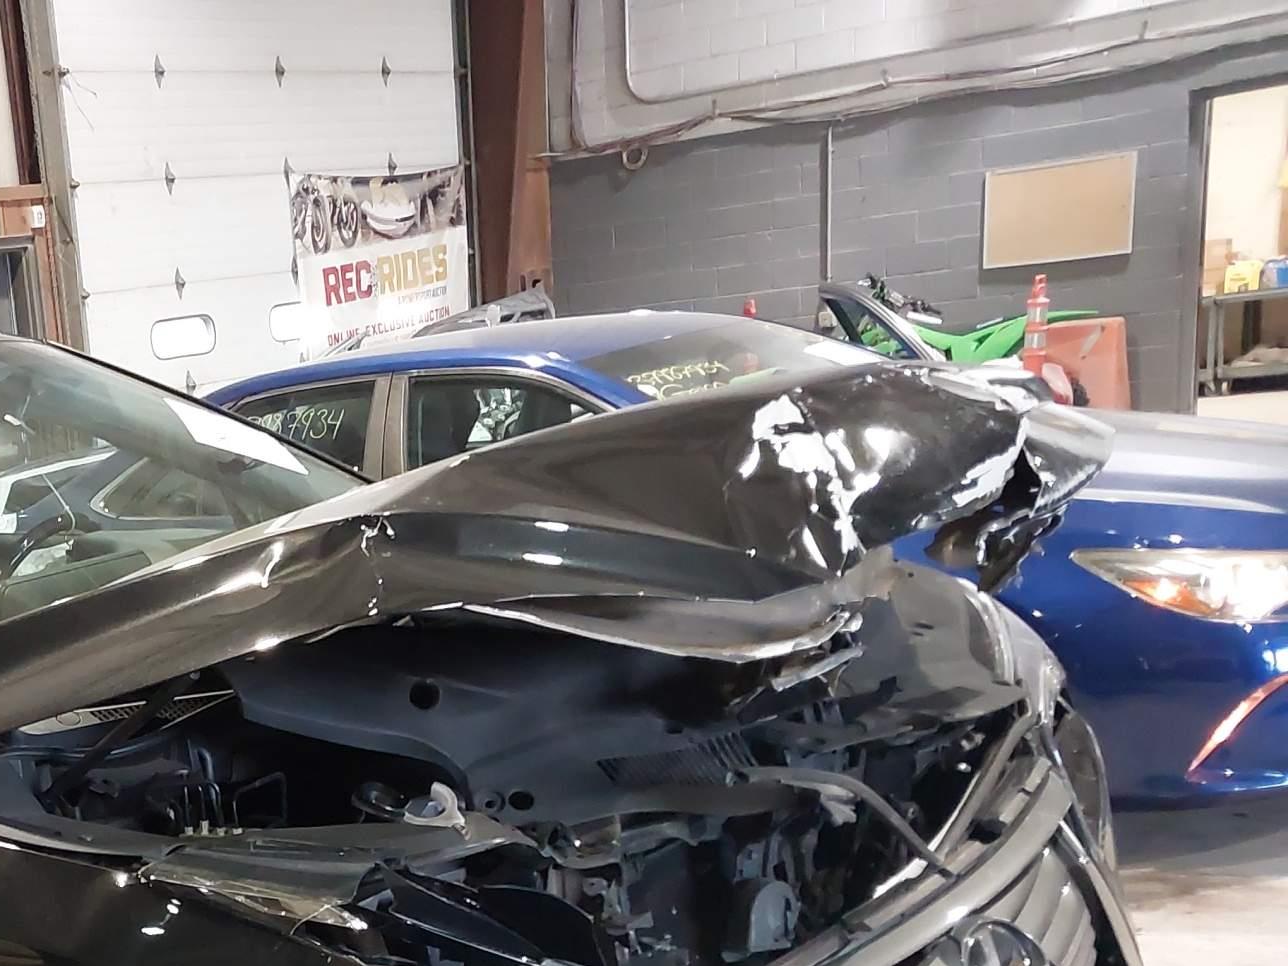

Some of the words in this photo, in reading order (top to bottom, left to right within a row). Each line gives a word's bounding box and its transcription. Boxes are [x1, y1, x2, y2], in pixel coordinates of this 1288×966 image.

[322, 259, 373, 306] REC
[377, 244, 448, 294] RIDES
[327, 327, 360, 346] ONLINE
[365, 317, 415, 337] EXCLUSIVE
[419, 305, 451, 324] AUCTION
